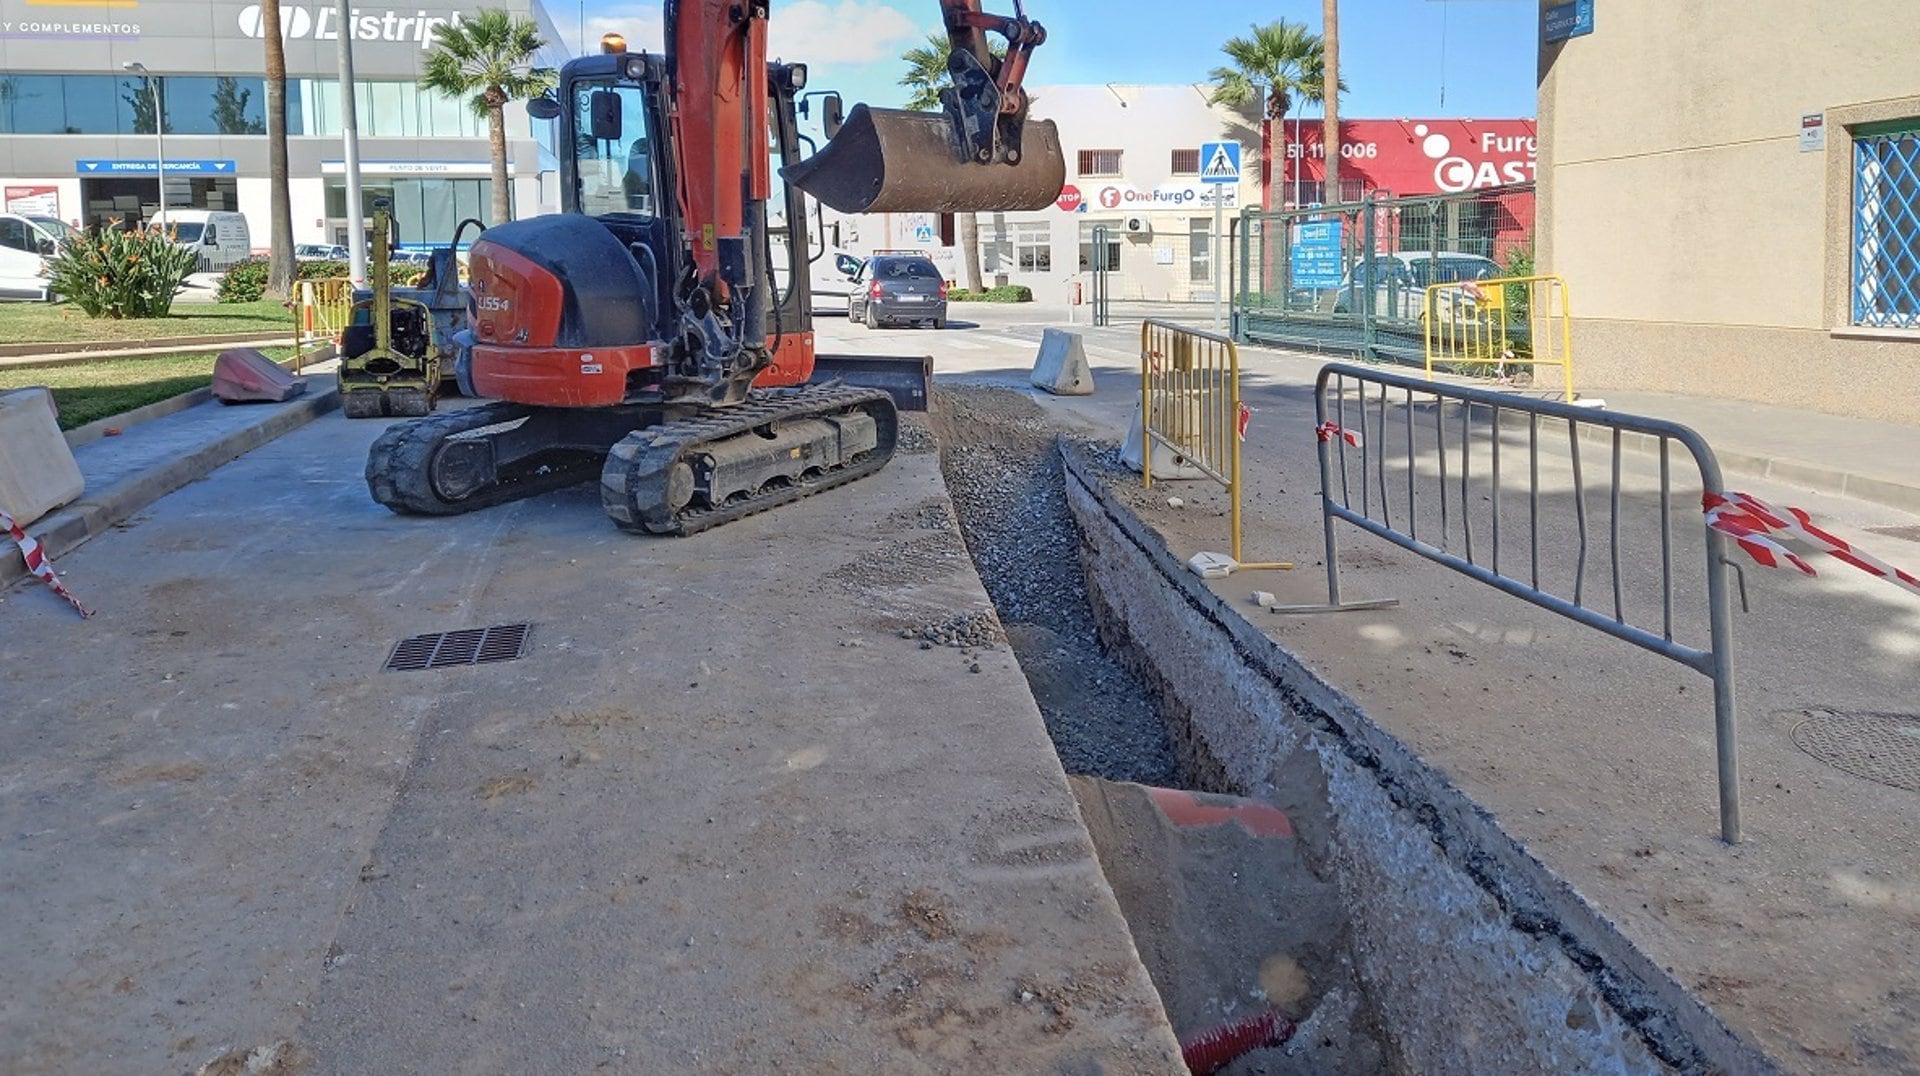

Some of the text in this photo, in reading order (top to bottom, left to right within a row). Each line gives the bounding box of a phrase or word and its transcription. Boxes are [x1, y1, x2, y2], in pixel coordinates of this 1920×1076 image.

[2, 22, 141, 34] Y COMPLEMENTOS
[1124, 188, 1196, 205] OneFurgO
